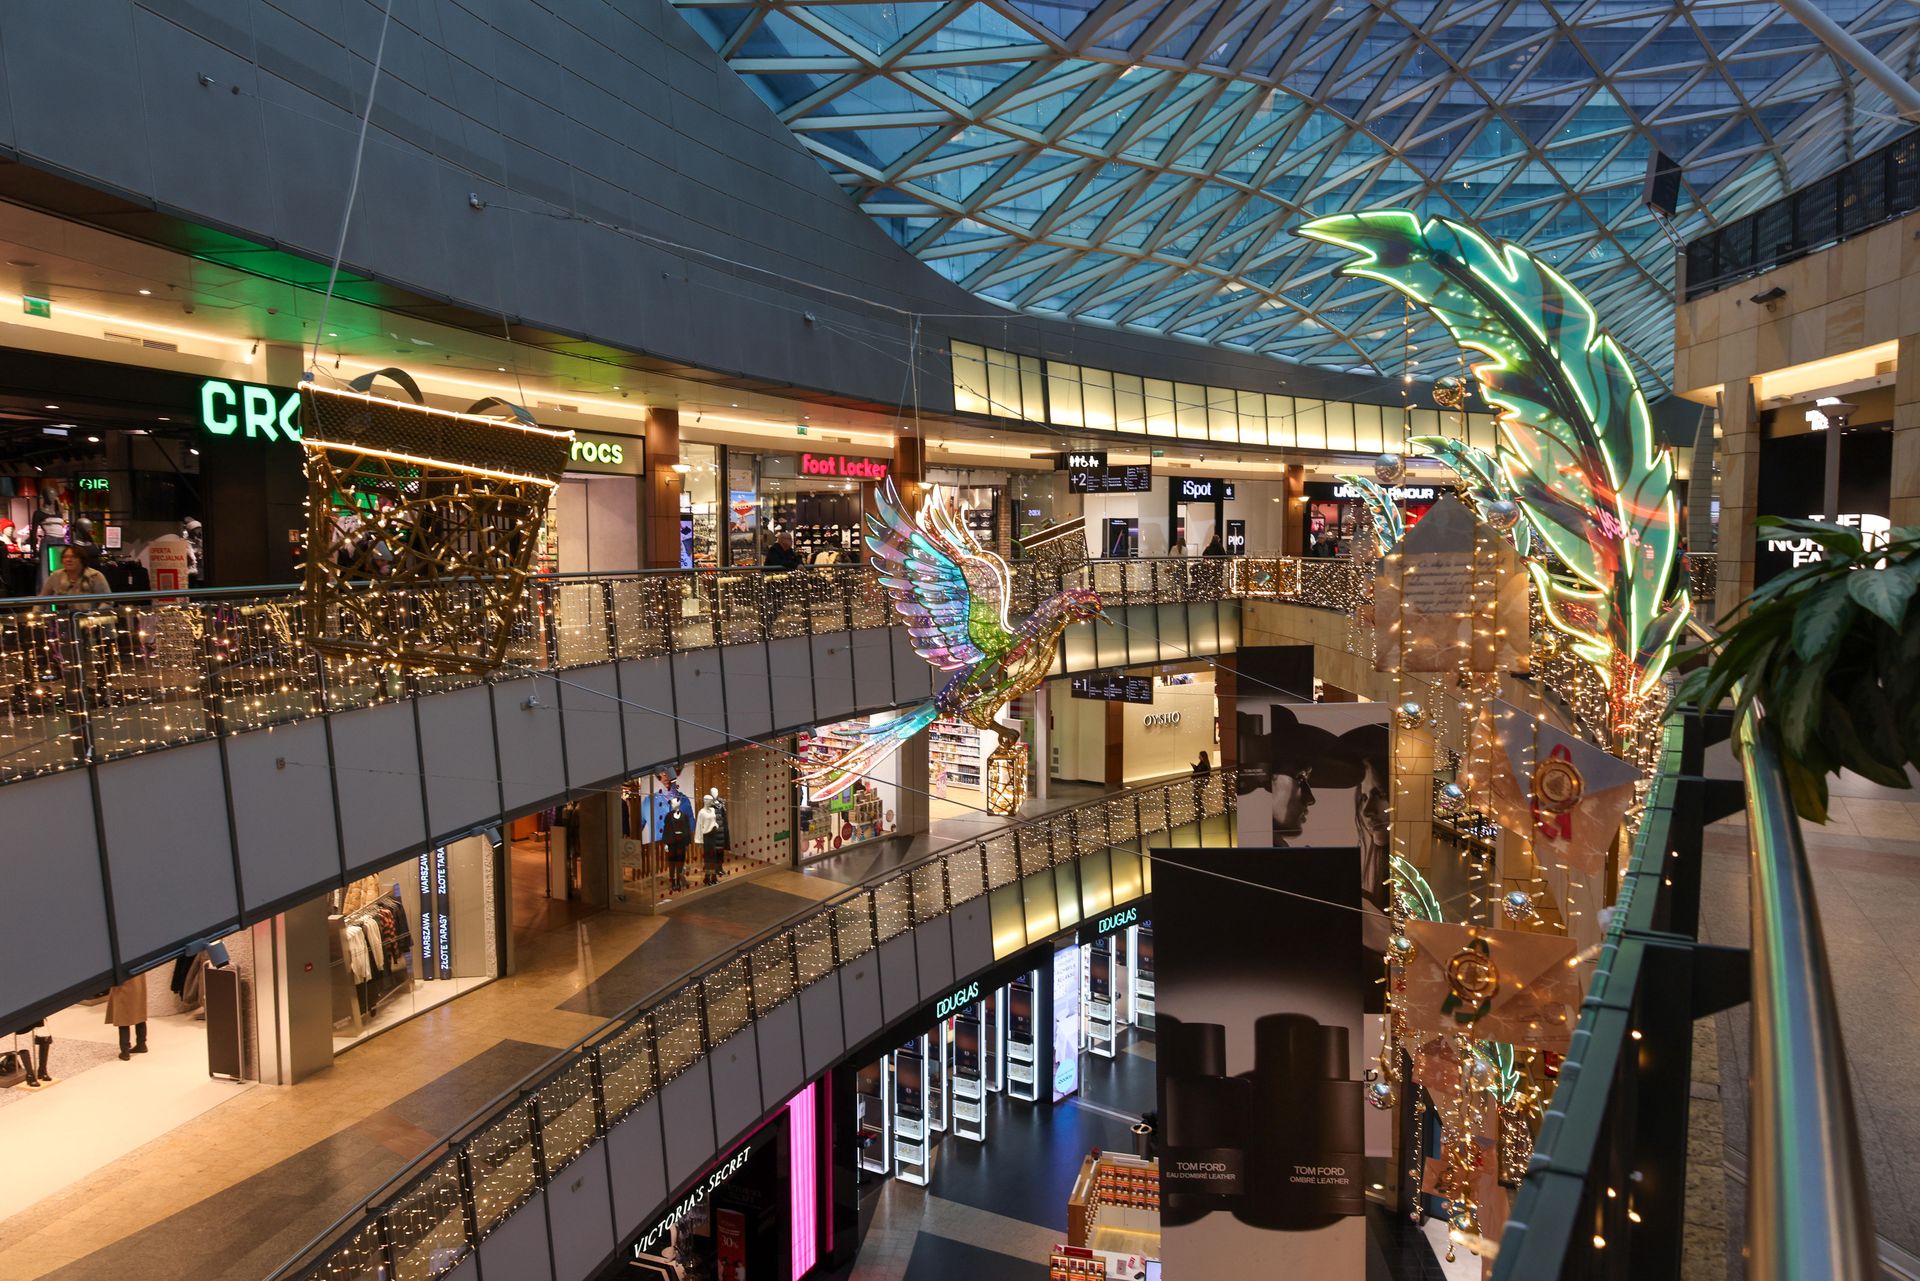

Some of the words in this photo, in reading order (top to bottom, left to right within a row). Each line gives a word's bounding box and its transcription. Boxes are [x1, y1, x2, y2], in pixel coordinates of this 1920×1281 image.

[571, 441, 623, 465] rocs
[802, 453, 837, 475] Foot
[839, 456, 887, 478] Locker
[1070, 473, 1087, 486] +2
[1183, 480, 1212, 499] iSpot
[1387, 487, 1434, 500] RMOUR
[1143, 711, 1181, 727] OYSHO
[437, 846, 445, 869] TARA
[420, 853, 430, 894] WARSZAW
[439, 914, 448, 942] TARASY
[1098, 907, 1137, 934] DOUGLAS
[422, 912, 432, 959] WARSZAWA
[936, 981, 979, 1018] DOUGLAS
[1176, 1162, 1198, 1171] TOM
[1199, 1163, 1226, 1172] FORD
[1293, 1165, 1316, 1175] TOM
[1317, 1167, 1345, 1176] FORD
[1316, 1177, 1350, 1185] LEATHER
[633, 1186, 705, 1259] VICTORIA'S
[707, 1146, 751, 1193] SECRET
